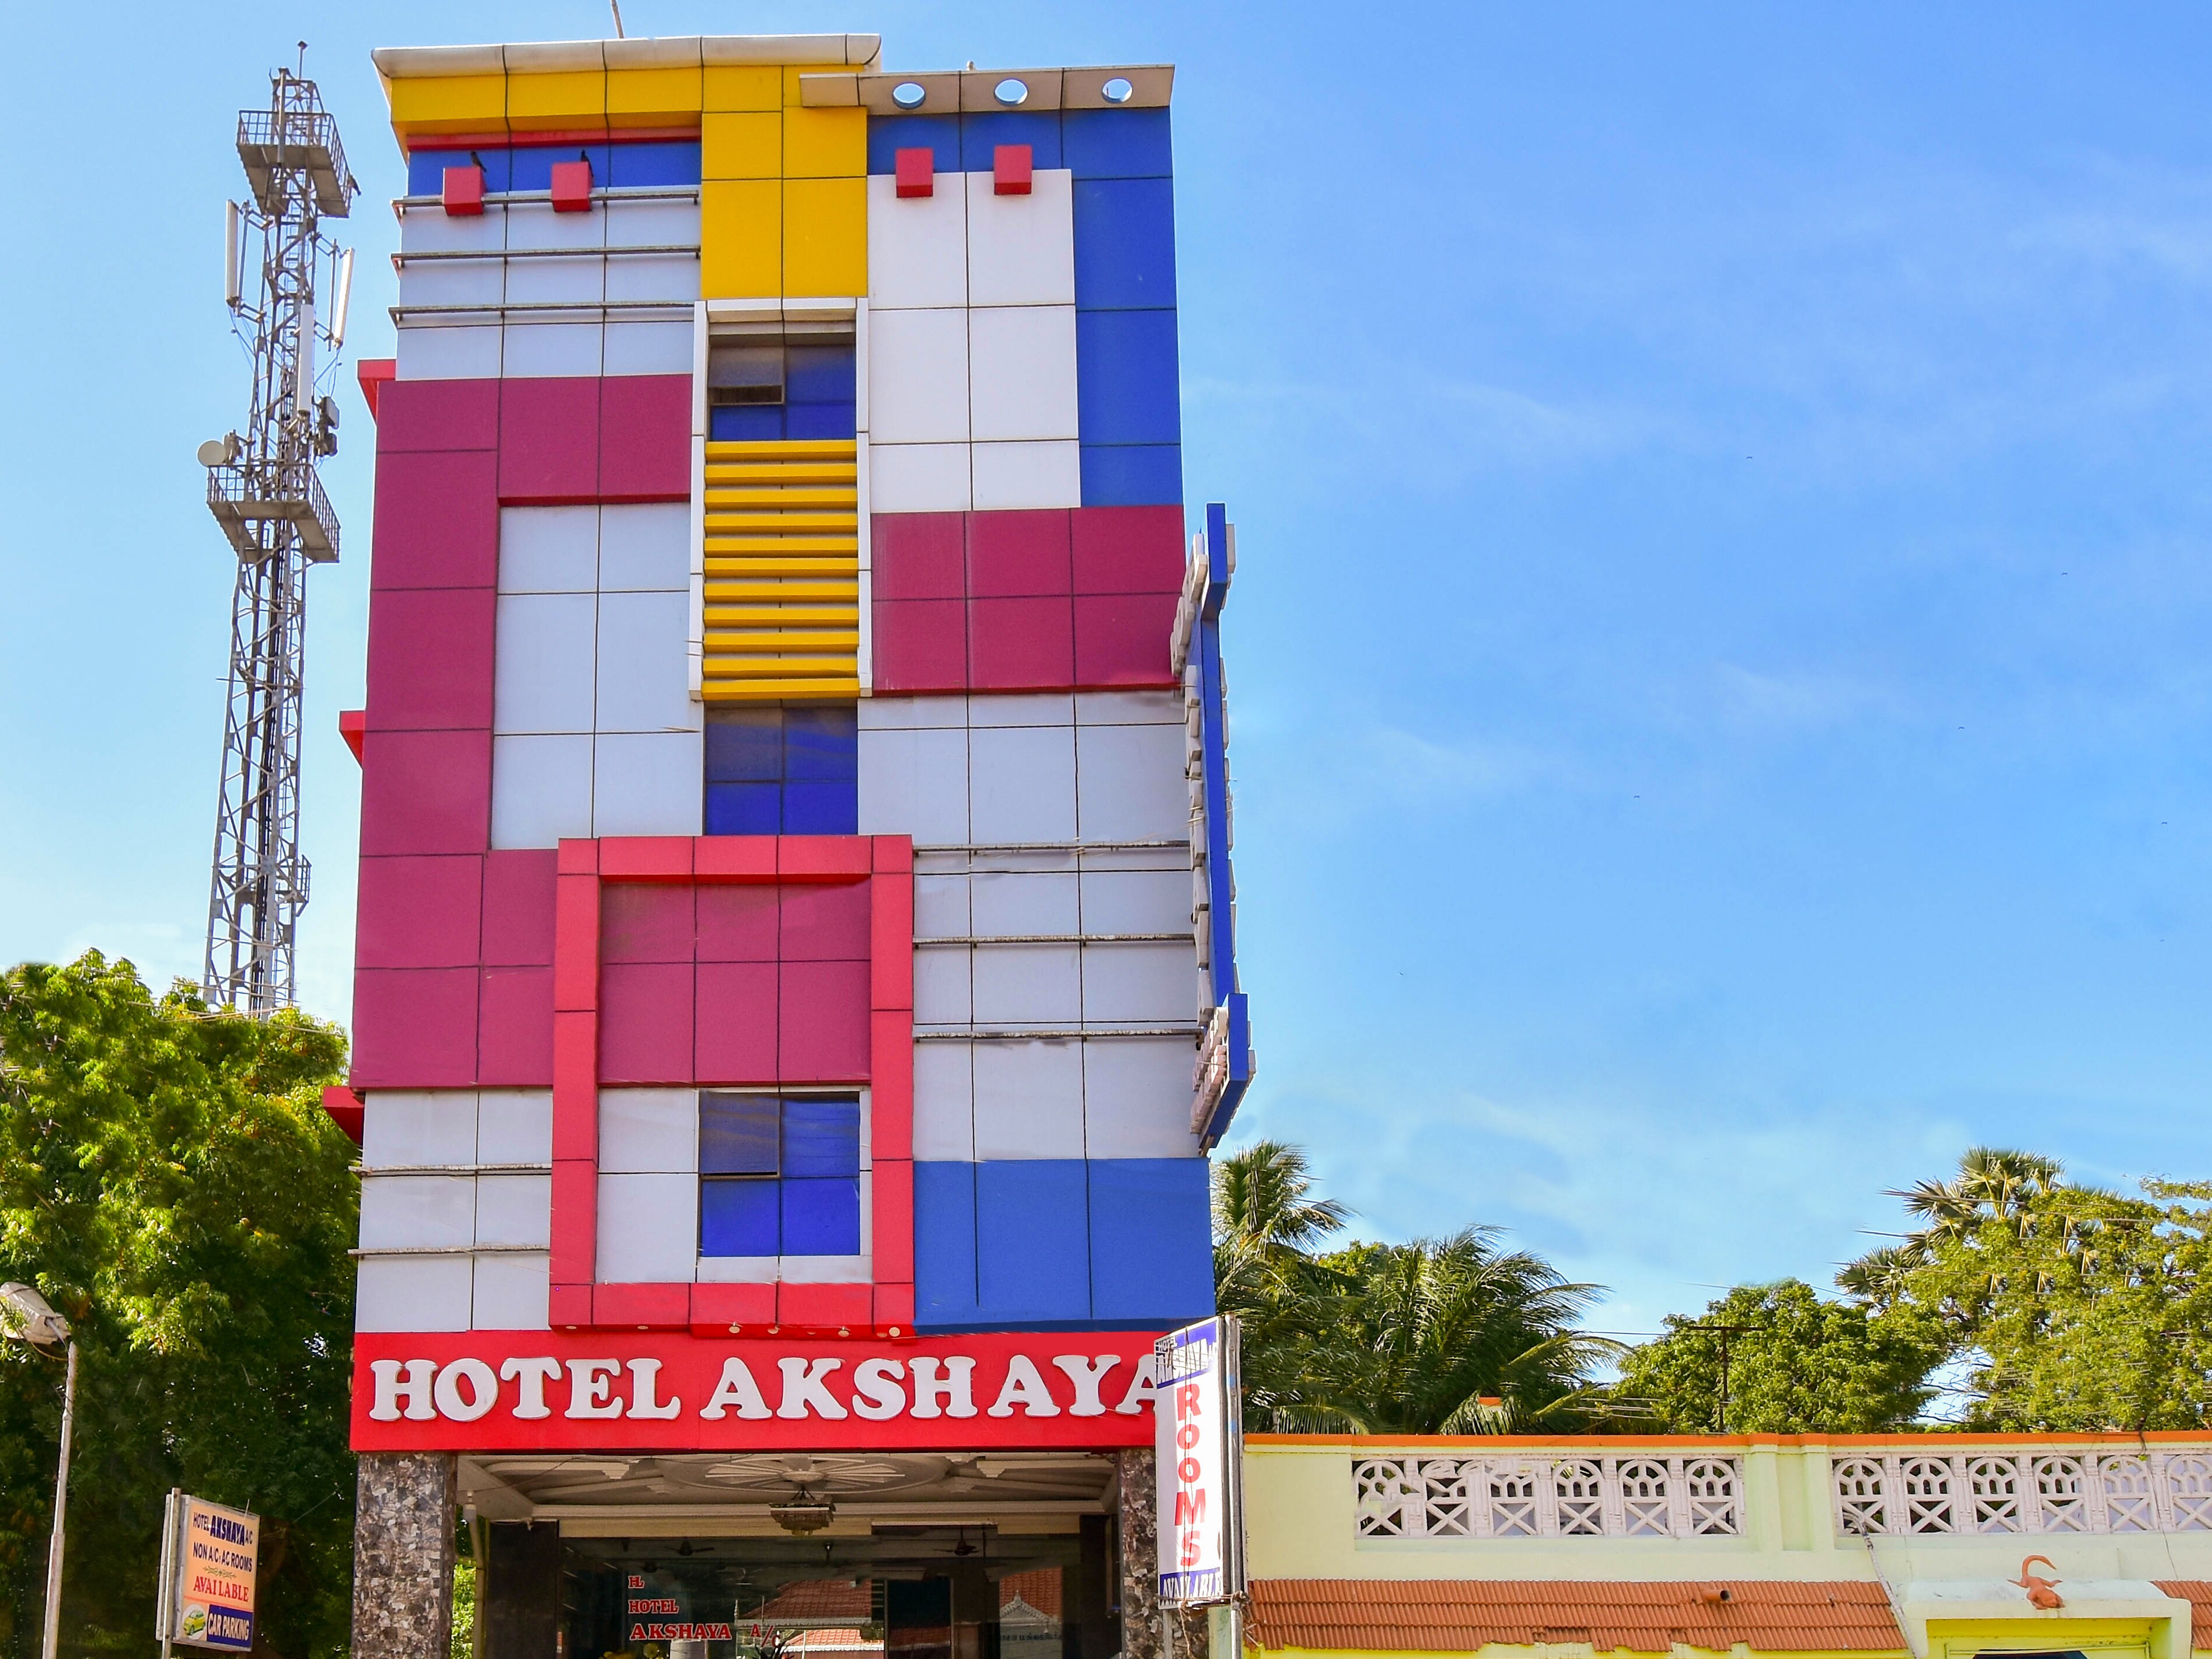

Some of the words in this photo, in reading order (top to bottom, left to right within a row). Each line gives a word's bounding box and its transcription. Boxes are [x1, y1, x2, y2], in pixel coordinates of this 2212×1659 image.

[369, 1357, 681, 1420] HOTEL
[1174, 1383, 1206, 1567] ROOMS
[193, 1512, 210, 1531] HOTEL
[210, 1515, 245, 1546] AKSHAYA
[193, 1542, 208, 1560] NON
[231, 1553, 252, 1572] ROOMS
[193, 1576, 249, 1602] AVAILABLE
[629, 1598, 679, 1613] HOTEL
[208, 1613, 222, 1637] CAR
[222, 1616, 250, 1641] PARKING
[630, 1622, 732, 1640] AKSHAYA
